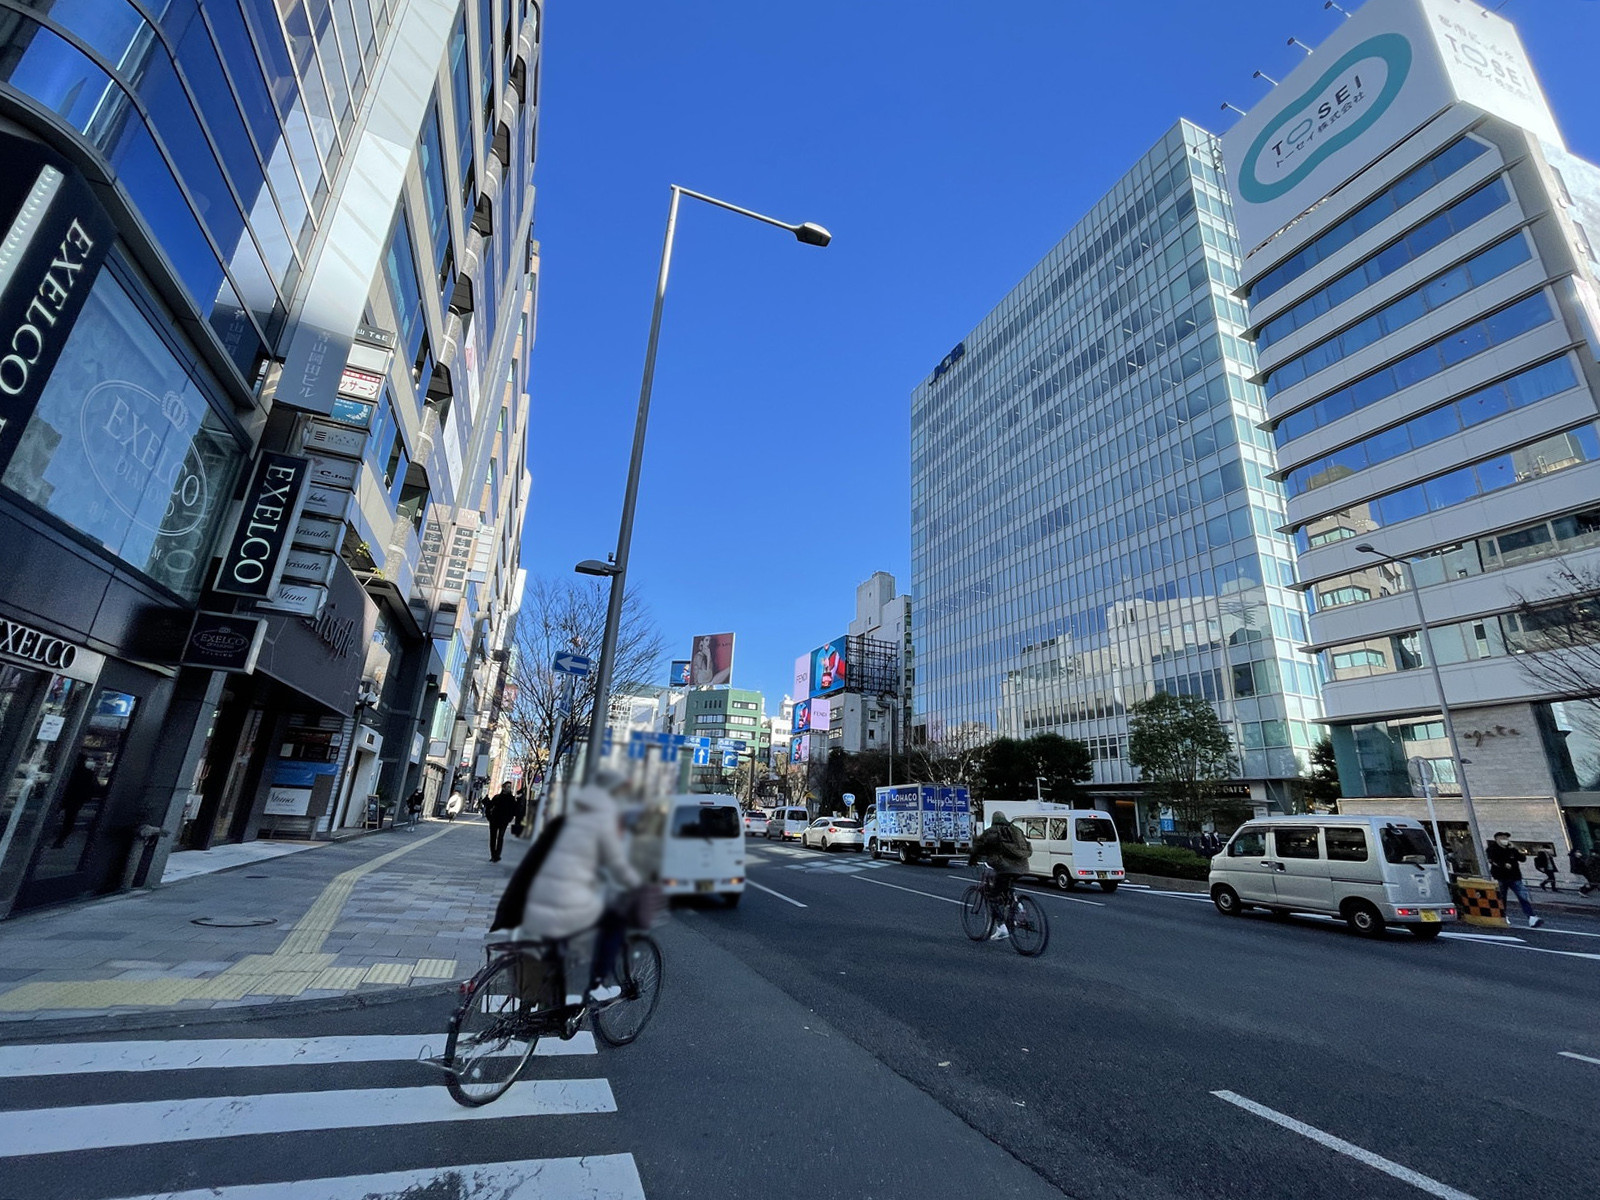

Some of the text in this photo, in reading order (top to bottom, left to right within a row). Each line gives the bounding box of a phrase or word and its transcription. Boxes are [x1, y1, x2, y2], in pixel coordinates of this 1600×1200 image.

[1272, 75, 1362, 156] TOSEI
[1276, 92, 1365, 168] トーセイ株式会社
[0, 217, 94, 395] EXELCO
[103, 396, 200, 507] EXELCO
[234, 464, 296, 584] EXELCO
[0, 620, 78, 670] XELCO
[200, 633, 245, 646] EXELCO
[891, 793, 917, 802] LOHACO
